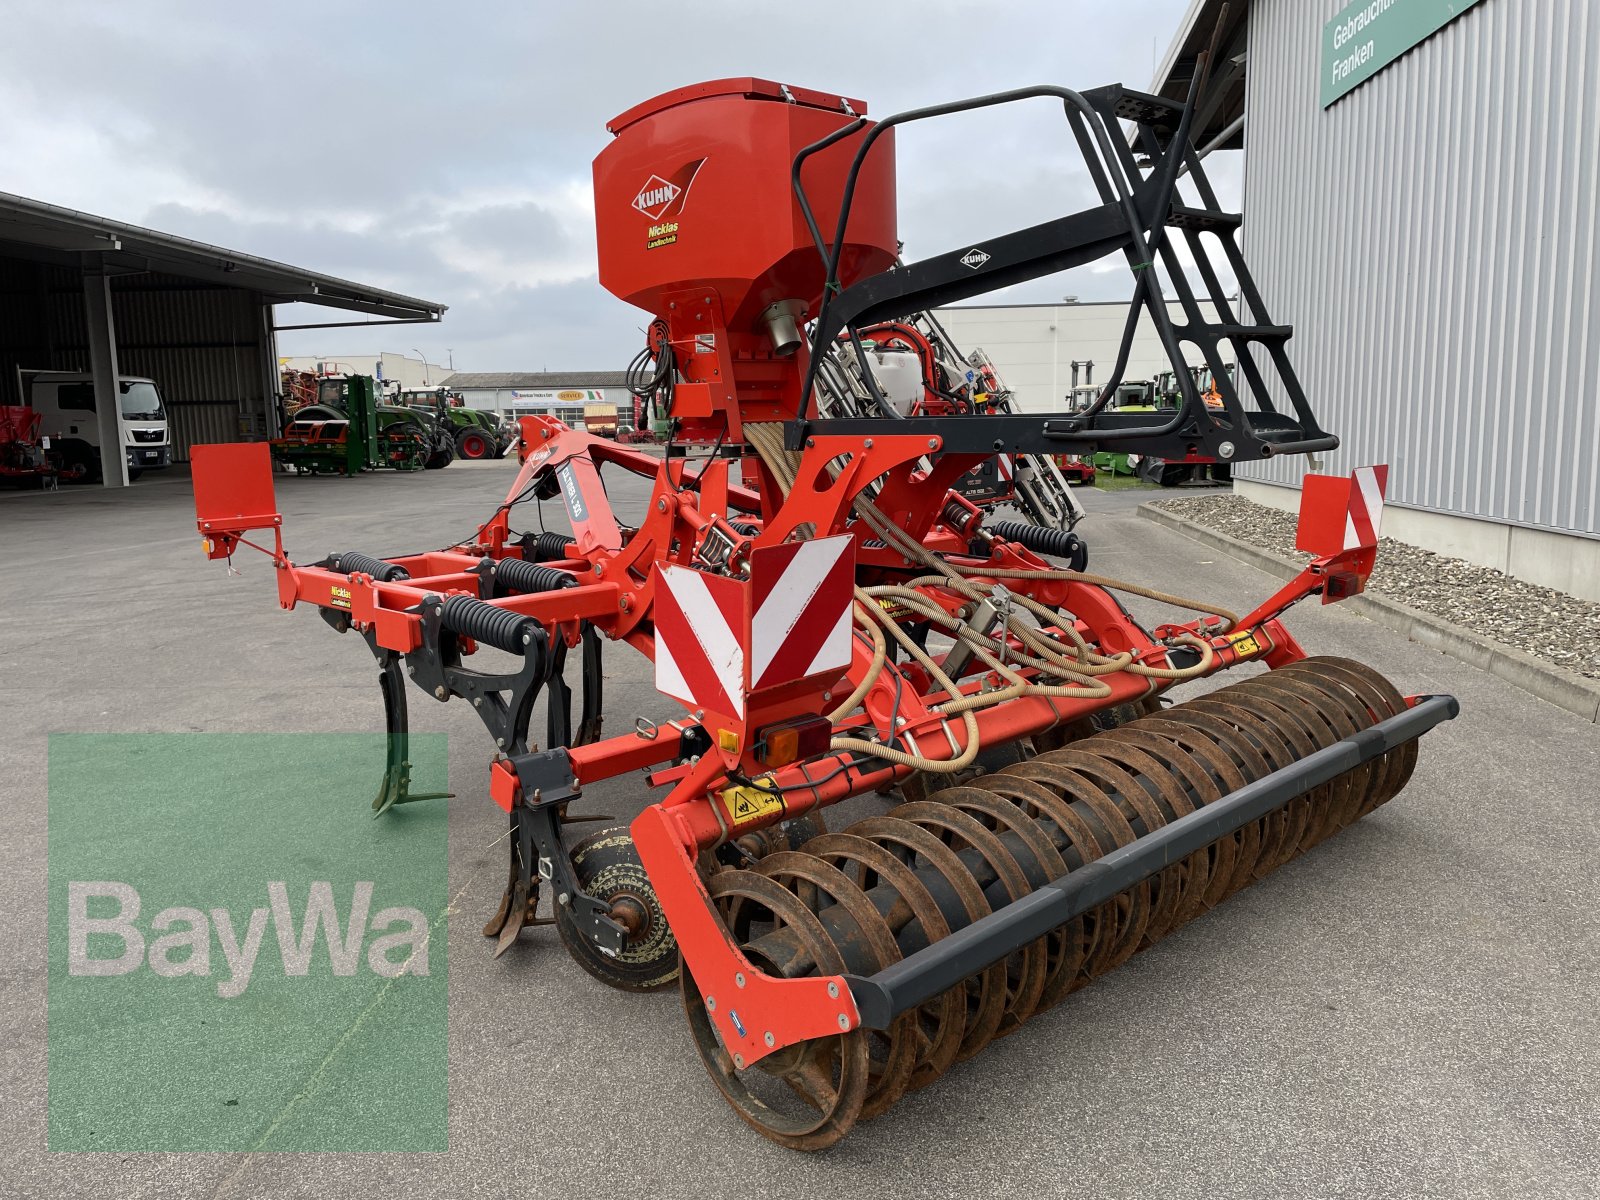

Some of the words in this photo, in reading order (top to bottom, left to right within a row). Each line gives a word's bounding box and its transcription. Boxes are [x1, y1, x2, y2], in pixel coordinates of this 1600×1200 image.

[1332, 39, 1374, 85] Franken
[638, 184, 674, 210] KUHN
[648, 222, 679, 238] Nicklas
[964, 254, 987, 264] KUHN
